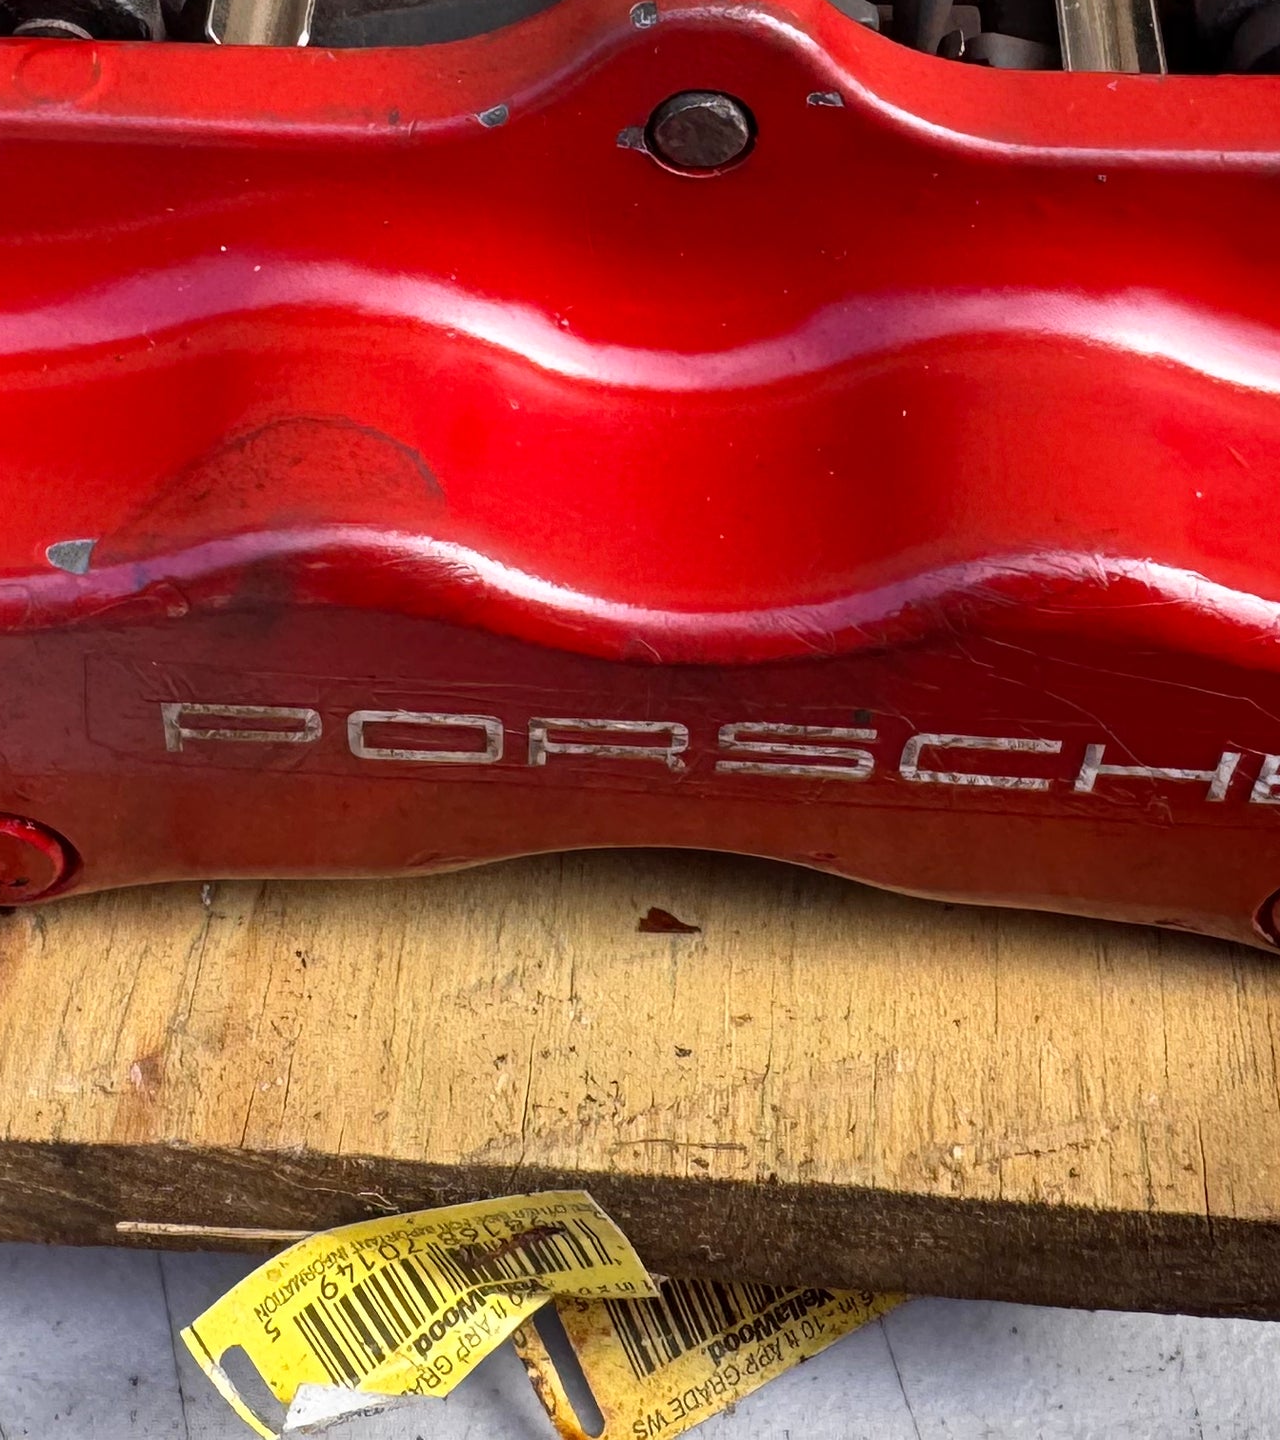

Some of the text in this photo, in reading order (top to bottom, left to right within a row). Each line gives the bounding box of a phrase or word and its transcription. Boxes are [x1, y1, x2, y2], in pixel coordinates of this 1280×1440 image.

[253, 1245, 351, 1323] INFORMATION
[320, 1238, 423, 1300] 70149
[263, 1317, 281, 1344] 5
[667, 1365, 741, 1421] GRADE
